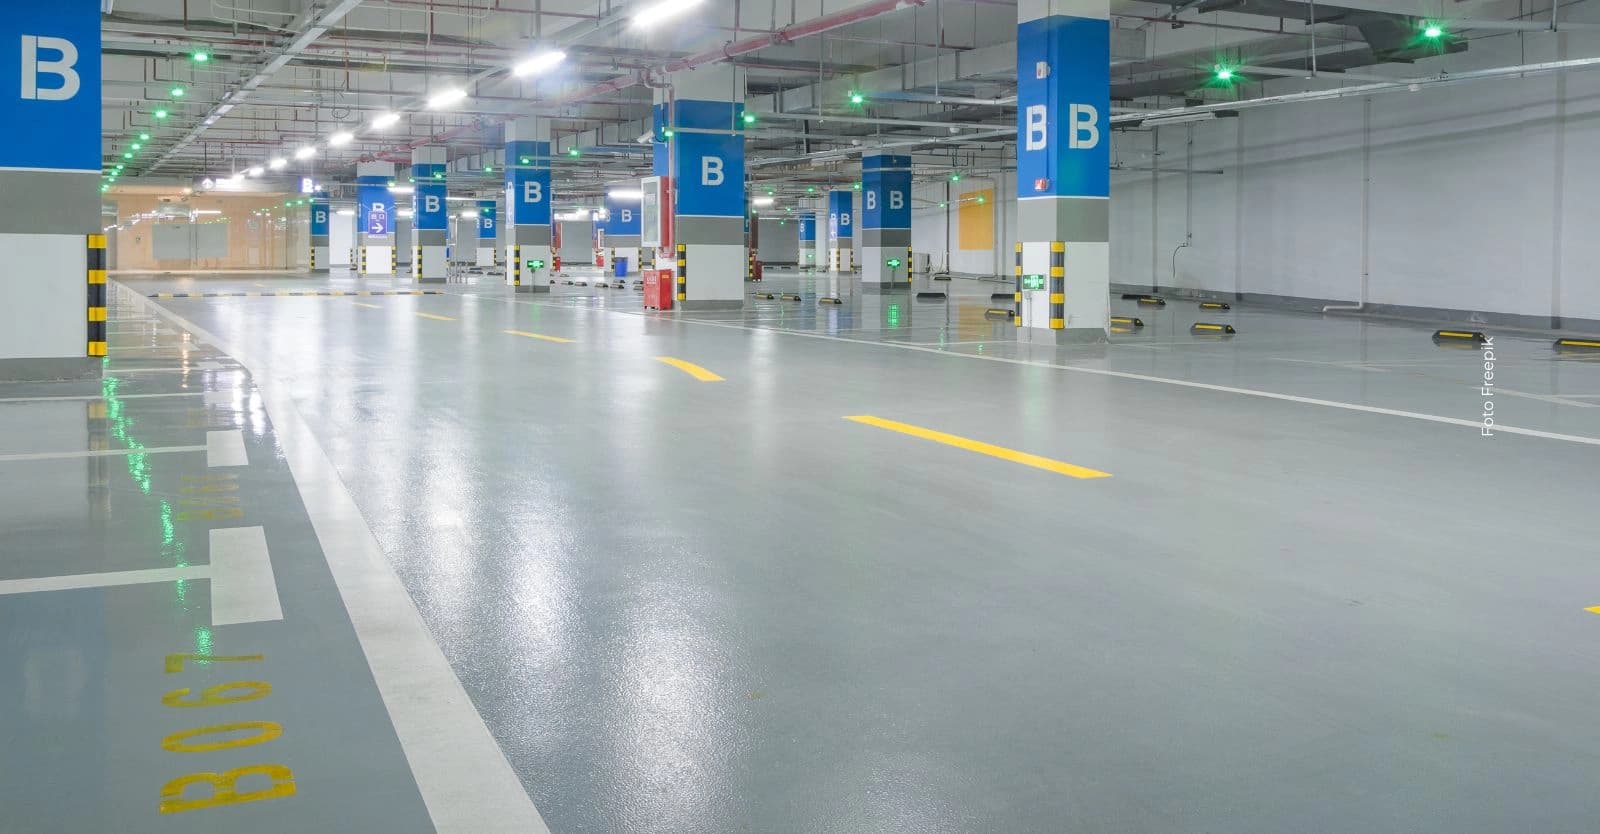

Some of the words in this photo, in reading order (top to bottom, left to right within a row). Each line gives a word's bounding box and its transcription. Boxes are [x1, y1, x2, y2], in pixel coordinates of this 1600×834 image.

[21, 35, 81, 101] B
[1026, 104, 1047, 151] B
[1068, 103, 1099, 150] B
[701, 156, 724, 186] B
[524, 181, 542, 203] B
[867, 191, 876, 210] B
[890, 191, 904, 209] B
[425, 195, 440, 213] B
[316, 211, 327, 223] B
[484, 219, 493, 229] B
[621, 209, 632, 222] B
[841, 213, 850, 225] B
[159, 652, 296, 815] B067
